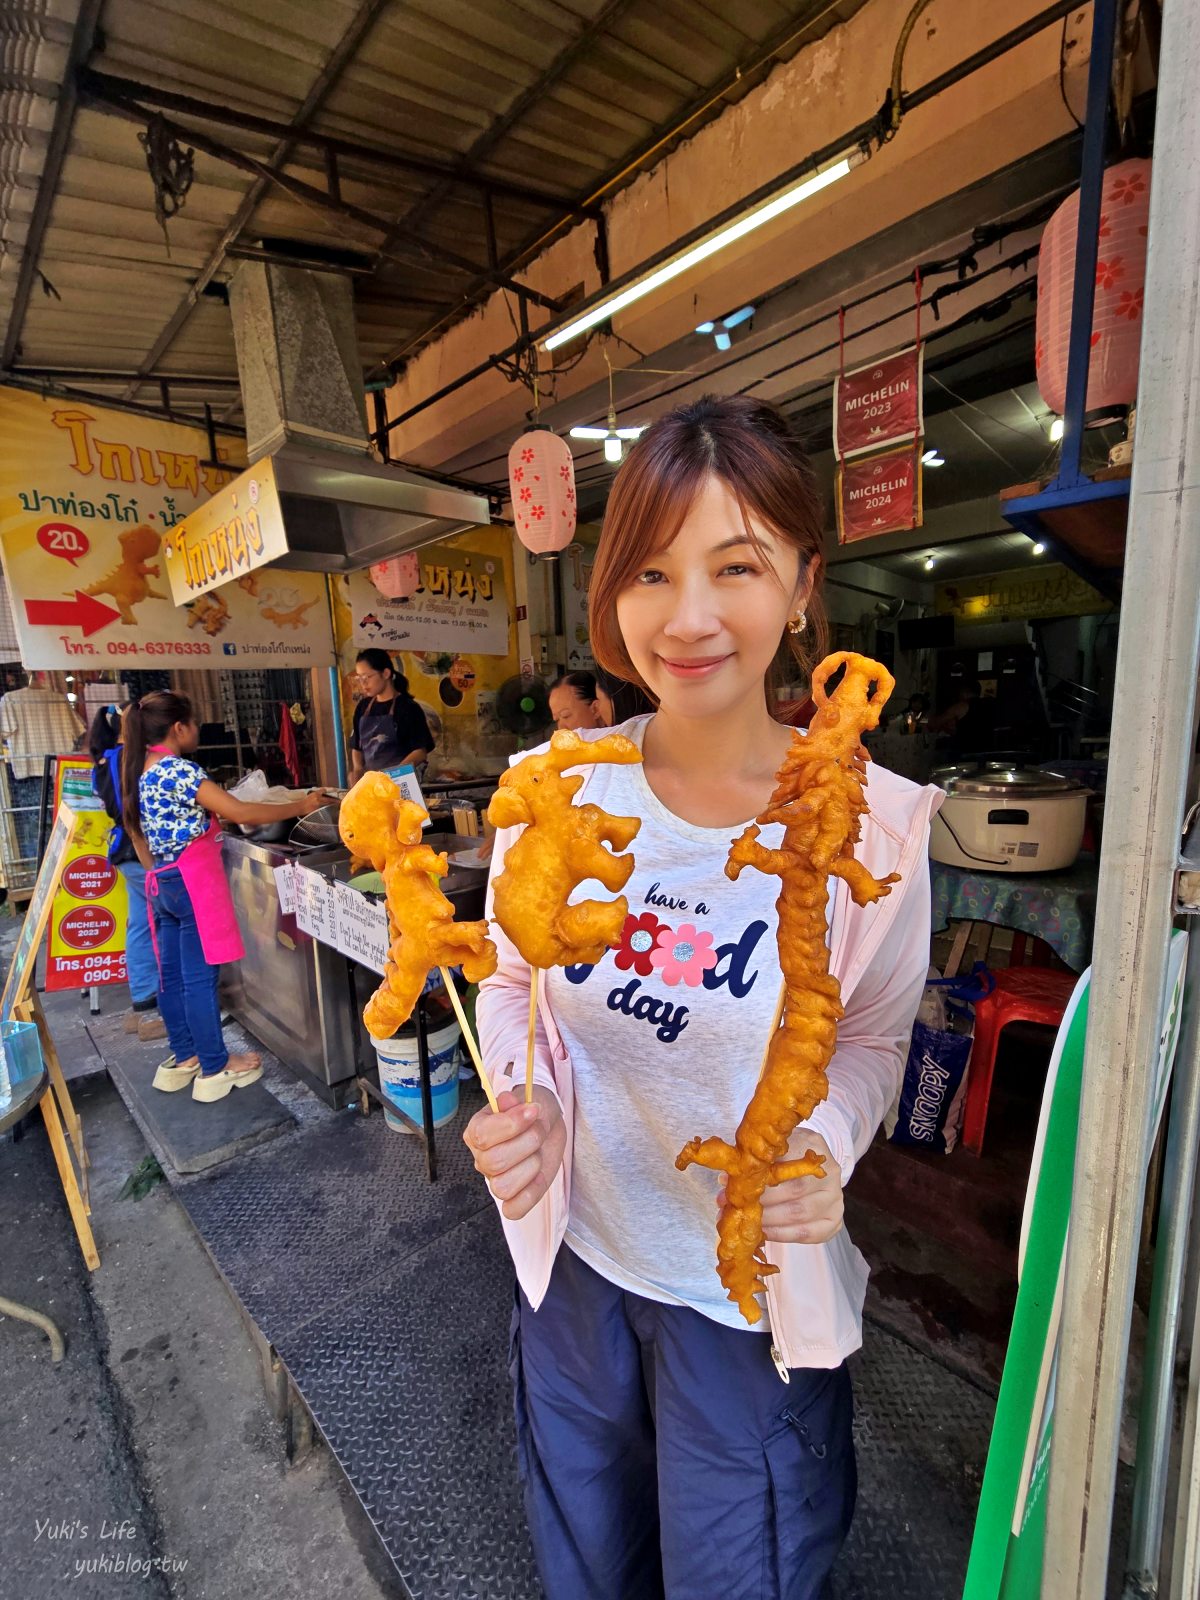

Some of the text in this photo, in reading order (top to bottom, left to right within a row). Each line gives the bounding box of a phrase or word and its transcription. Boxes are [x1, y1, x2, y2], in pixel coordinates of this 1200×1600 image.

[845, 379, 910, 412] MICHELIN
[862, 402, 891, 420] 2023
[51, 410, 236, 498] โกเหน่
[849, 477, 908, 500] MICHELIN
[865, 495, 891, 509] 2024
[19, 489, 139, 523] ปาท่องโก๋
[175, 491, 264, 590] โกเหน่ง
[59, 636, 99, 656] โทร.
[107, 642, 211, 656] 094-6376333
[69, 871, 112, 880] MICHELIN
[644, 881, 710, 916] have a
[66, 920, 110, 929] MICHELIN
[78, 929, 99, 937] 2023
[606, 978, 690, 1043] day
[909, 1055, 950, 1142] SNOOPY
